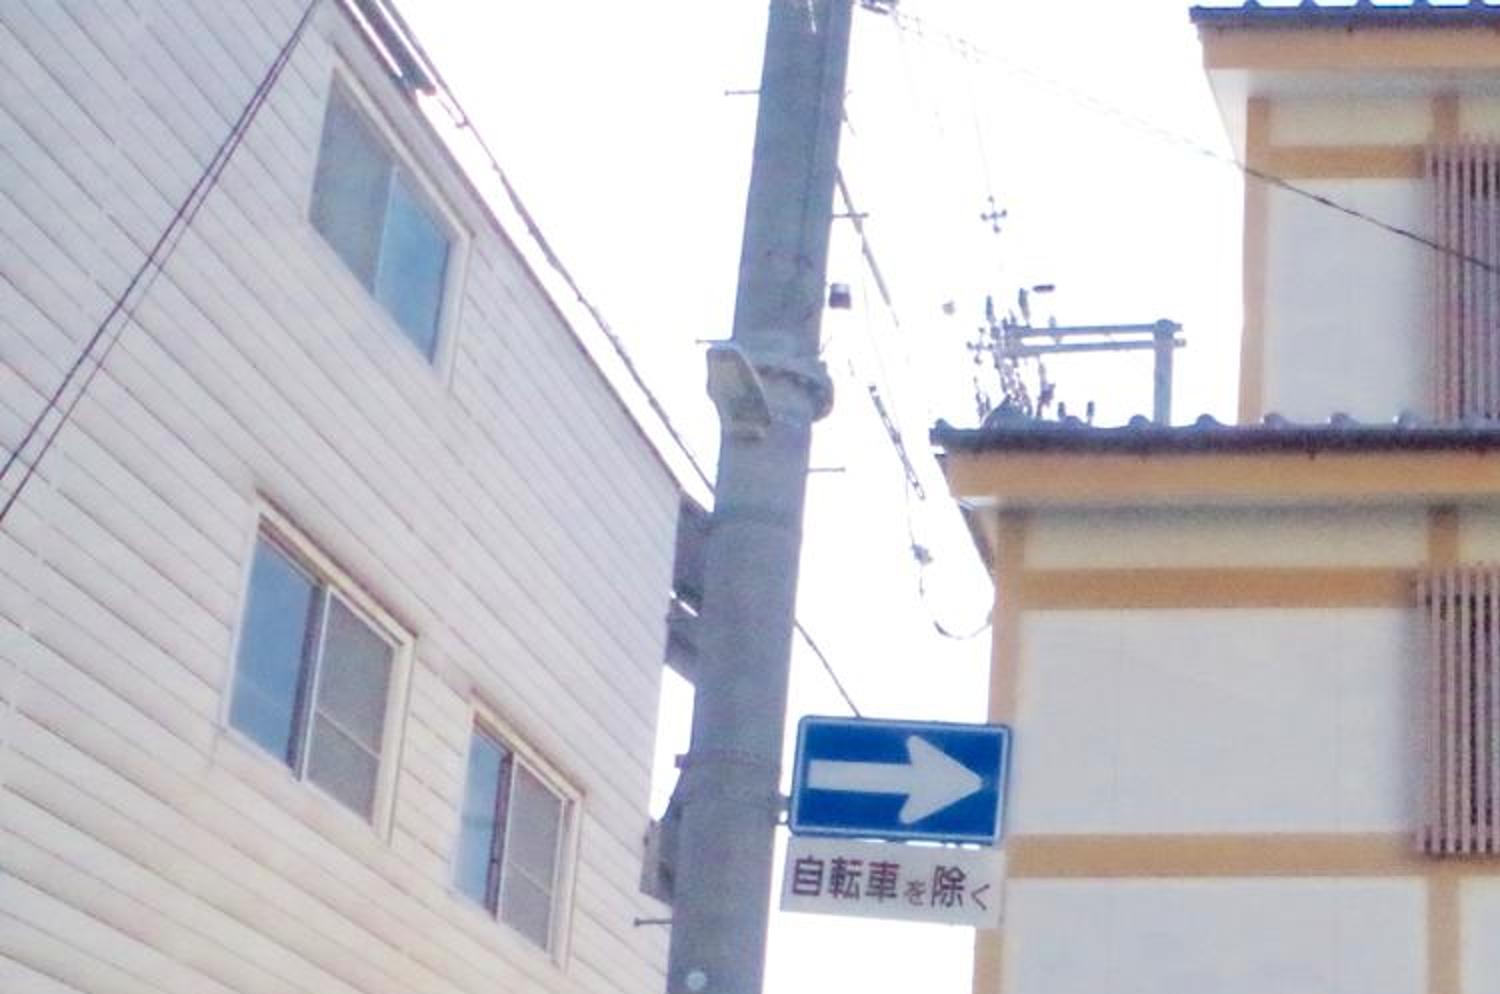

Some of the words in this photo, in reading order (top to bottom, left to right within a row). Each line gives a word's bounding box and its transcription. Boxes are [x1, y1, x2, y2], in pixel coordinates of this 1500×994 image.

[791, 855, 990, 911] 自転車を除く
